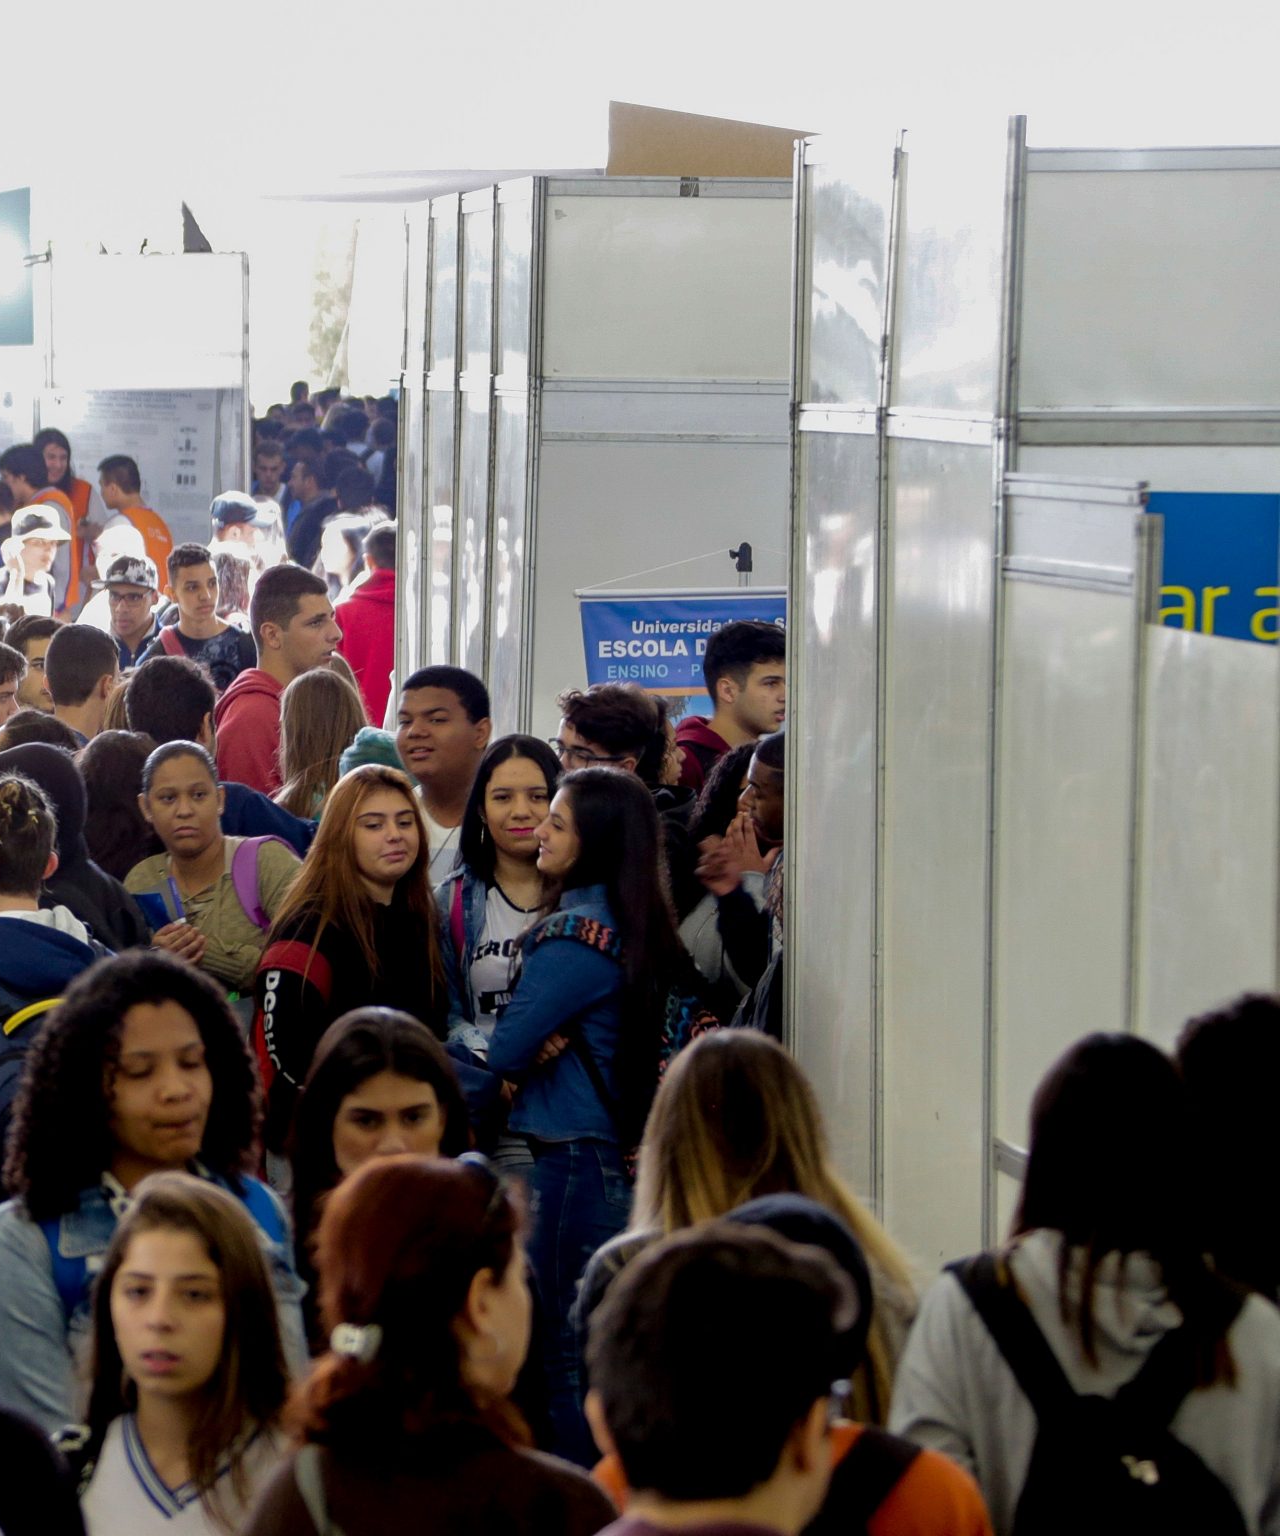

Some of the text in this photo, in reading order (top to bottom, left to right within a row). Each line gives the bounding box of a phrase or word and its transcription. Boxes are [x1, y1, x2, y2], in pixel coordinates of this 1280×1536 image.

[632, 619, 732, 634] Universida
[598, 638, 688, 658] ESCOLA
[607, 663, 669, 679] ENSINO
